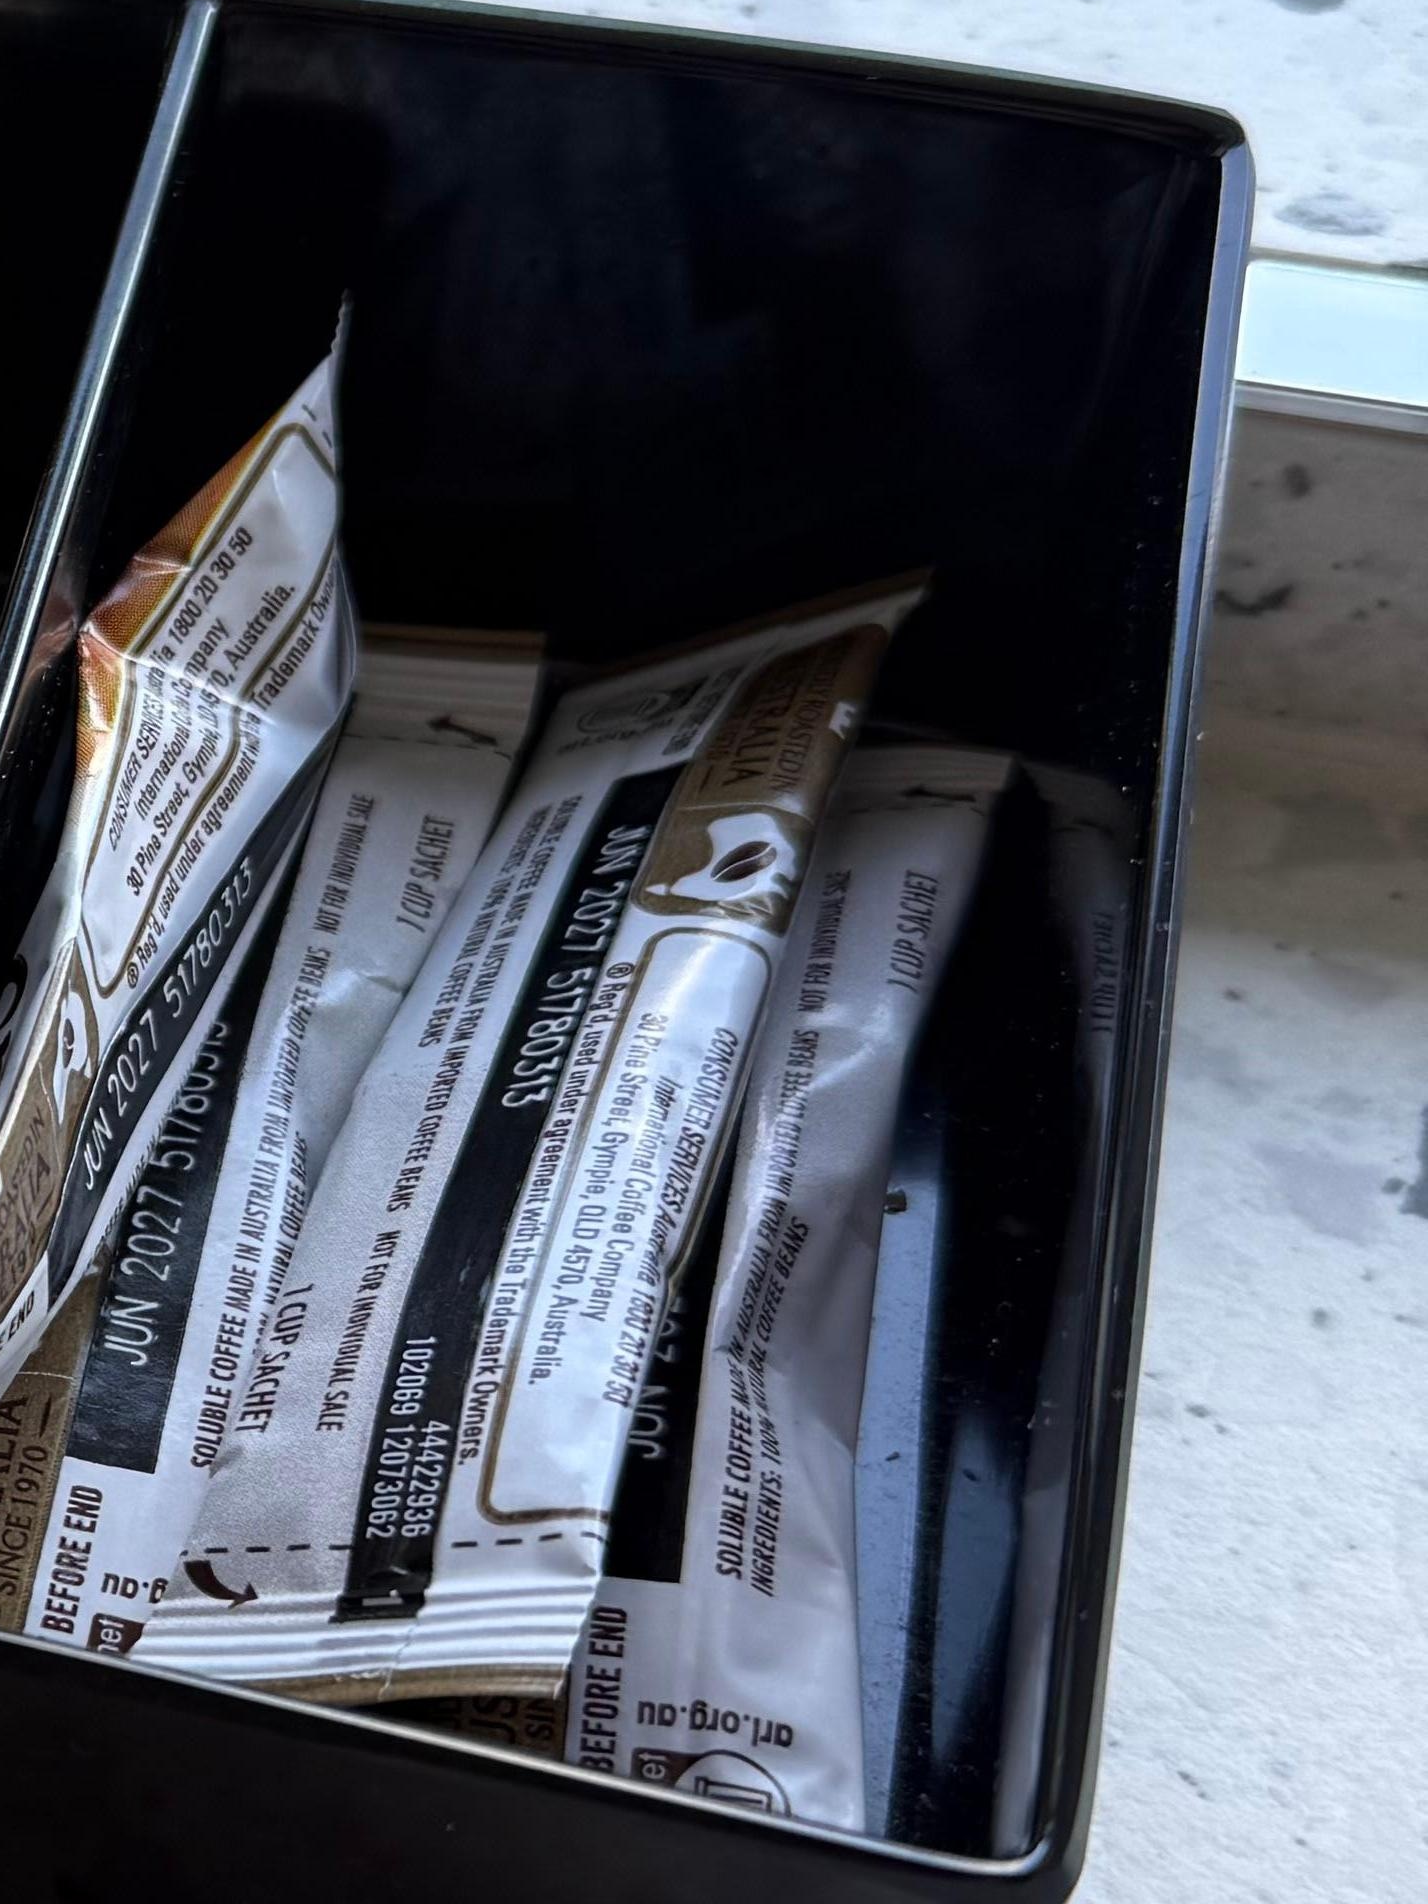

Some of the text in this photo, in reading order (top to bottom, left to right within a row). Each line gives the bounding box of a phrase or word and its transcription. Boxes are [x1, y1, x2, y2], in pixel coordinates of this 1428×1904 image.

[223, 581, 296, 672] Australia.
[107, 753, 143, 852] CONSUMER
[168, 598, 203, 646] 1800
[194, 573, 219, 608] 20
[210, 551, 236, 581] 30
[227, 526, 254, 557] 50
[134, 616, 231, 822] International Company
[125, 618, 321, 990] ® Reg'd, used under agreement Trademark
[152, 780, 190, 838] Street,
[346, 792, 375, 821] SALE
[135, 834, 162, 875] Pine
[327, 820, 368, 887] INDIVIDUAL
[409, 813, 455, 882] SACHET
[591, 823, 654, 876] JUN
[126, 872, 145, 897] 30
[320, 883, 352, 911] FOR
[400, 881, 436, 921] CUP
[560, 879, 630, 953] 2027
[895, 869, 940, 940] SACHET
[312, 906, 343, 936] NOT
[807, 896, 845, 961] INDIVIDUAL
[297, 944, 333, 990] BEANS
[417, 909, 499, 1049] NATURAL COFFEE BEANS
[802, 959, 836, 989] FOR
[889, 937, 926, 980] CUP
[82, 1107, 113, 1192] JUN
[107, 1007, 158, 1118] 2027
[162, 862, 254, 1020] 51780313
[287, 987, 320, 1039] COFFEE
[640, 1012, 670, 1033] 30
[797, 987, 827, 1013] NOT
[500, 966, 594, 1108] 51780313
[625, 1030, 662, 1076] Pine
[789, 1028, 821, 1078] BEANS
[267, 1037, 302, 1114] IMPORTED
[686, 1026, 740, 1131] CONSUMER
[778, 1070, 815, 1120] COFFEE
[257, 1111, 291, 1158] FROM
[578, 1131, 630, 1200] Gympie,
[657, 1123, 707, 1214] SERVICES
[765, 1118, 803, 1199] IMPORTED
[239, 1158, 281, 1243] AUSTRALIA
[315, 940, 512, 1433] AUSTRALIA FROM IMPORTED COFFEE BEANS NOT FOR INDIVIDUAL SALE
[456, 961, 636, 1466] ® Reg'd, used under agreement with the Trademark Owners.
[579, 1074, 684, 1322] International Coffee Company
[119, 1183, 186, 1283] 2027
[233, 1241, 264, 1265] IN
[571, 1204, 607, 1241] QLD
[636, 1203, 677, 1288] Australia
[773, 1214, 809, 1284] BEANS
[223, 1263, 258, 1313] MADE
[552, 1247, 594, 1291] 4570,
[734, 1242, 771, 1345] AUSTRALIA
[5, 1289, 36, 1346] END
[102, 1293, 161, 1368] JUN
[269, 1301, 308, 1347] CUP
[527, 1296, 579, 1386] Australia.
[625, 1288, 657, 1331] 1800
[754, 1275, 787, 1351] COFFEE
[209, 1312, 247, 1382] COFFEE
[609, 1356, 641, 1384] 30
[617, 1331, 647, 1360] 20
[727, 1338, 745, 1366] IN
[190, 1384, 233, 1469] SOLUBLE
[233, 1351, 291, 1434] SACHET
[601, 1379, 634, 1408] 50
[364, 1334, 439, 1541] 102069 12073062
[724, 1404, 755, 1481] COFFEE
[758, 1410, 784, 1466] 100%
[12, 1446, 49, 1508] 1970
[400, 1419, 452, 1539] 44422936
[40, 1483, 105, 1636] BEFORE END
[715, 1477, 750, 1582] SOLUBLE
[750, 1467, 784, 1598] INGREDIENTS:
[579, 1606, 628, 1773] BEFORE END
[636, 1700, 795, 1749] arl.org.au
